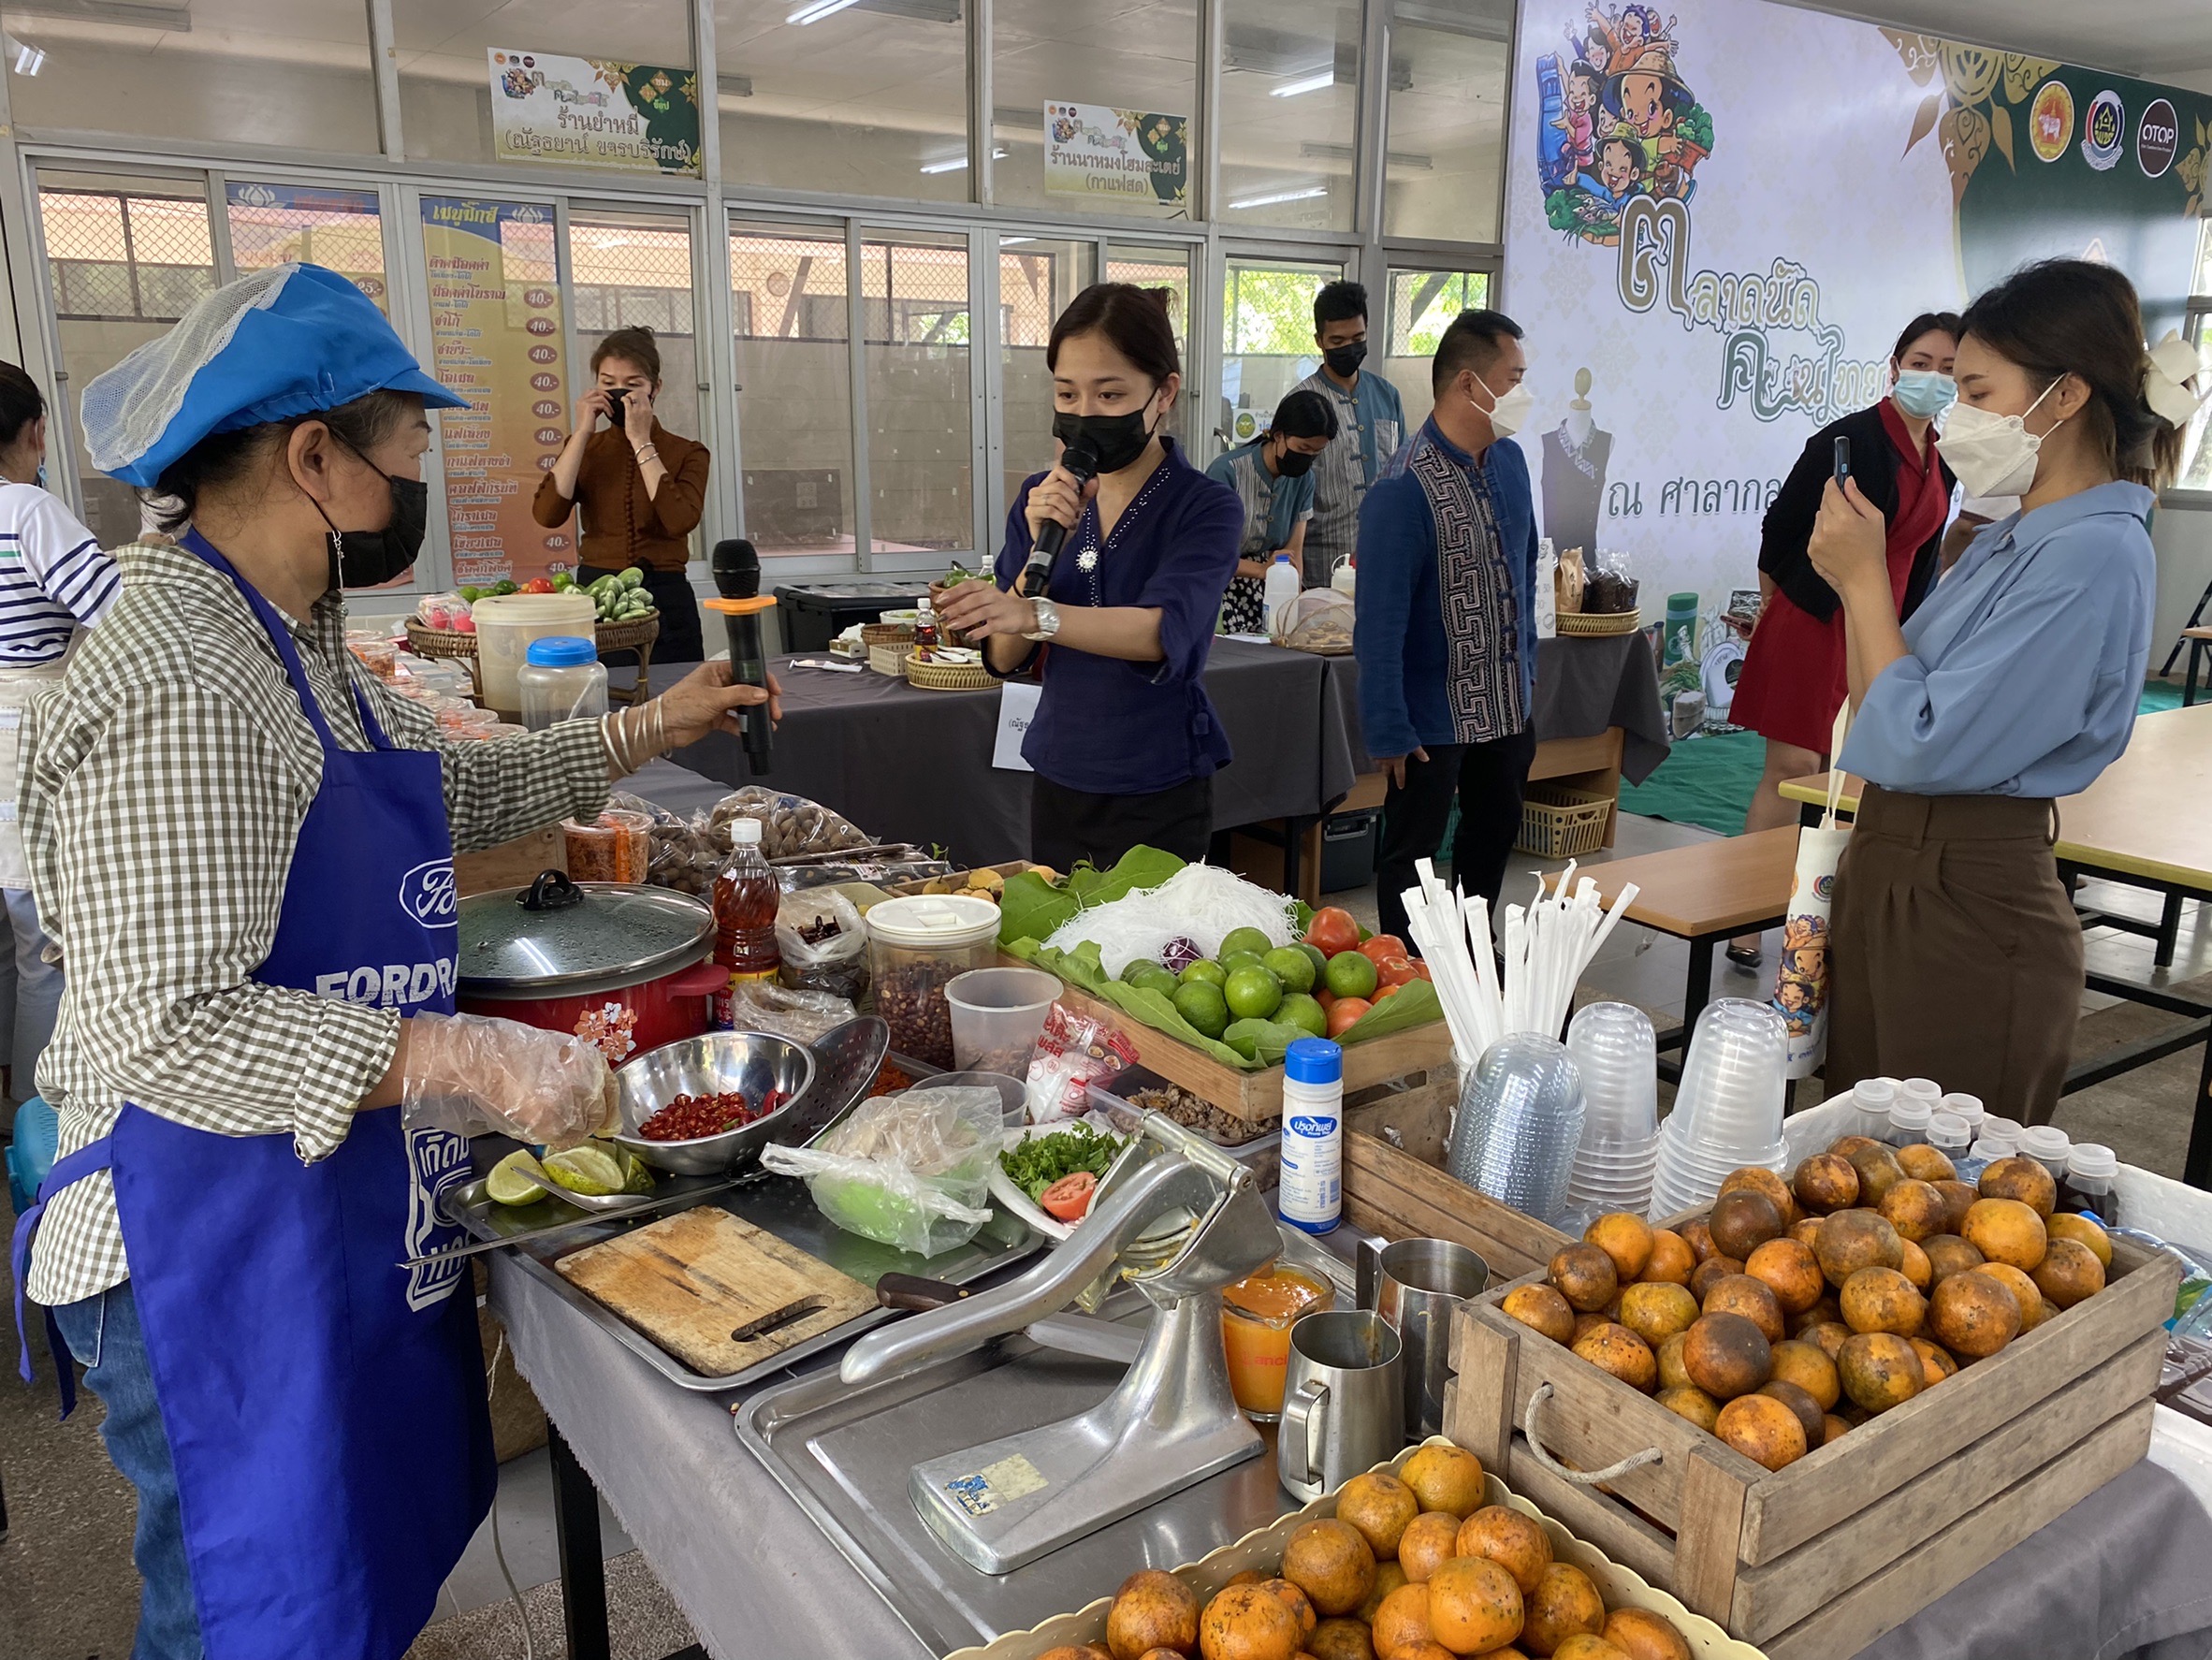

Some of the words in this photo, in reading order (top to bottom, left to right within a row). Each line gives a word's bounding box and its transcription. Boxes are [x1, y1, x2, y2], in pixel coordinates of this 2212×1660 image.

[558, 106, 639, 136] ร้านยำหมี่
[2142, 123, 2176, 144] OTOP
[1085, 172, 1149, 196] (กาแฟสด)
[1619, 196, 1821, 331] ตลาดนัด
[357, 280, 382, 295] 25.-
[528, 292, 552, 305] 40.-
[530, 320, 554, 332] 40.-
[531, 348, 556, 360] 40.-
[534, 376, 558, 387] 40.-
[536, 403, 560, 415] 40.-
[538, 430, 561, 442] 40.-
[541, 457, 556, 468] 40
[1608, 480, 1643, 517] ณ
[1659, 475, 1783, 516] ศาลากล
[546, 536, 570, 547] 40.-
[1037, 1034, 1065, 1058] พลัส
